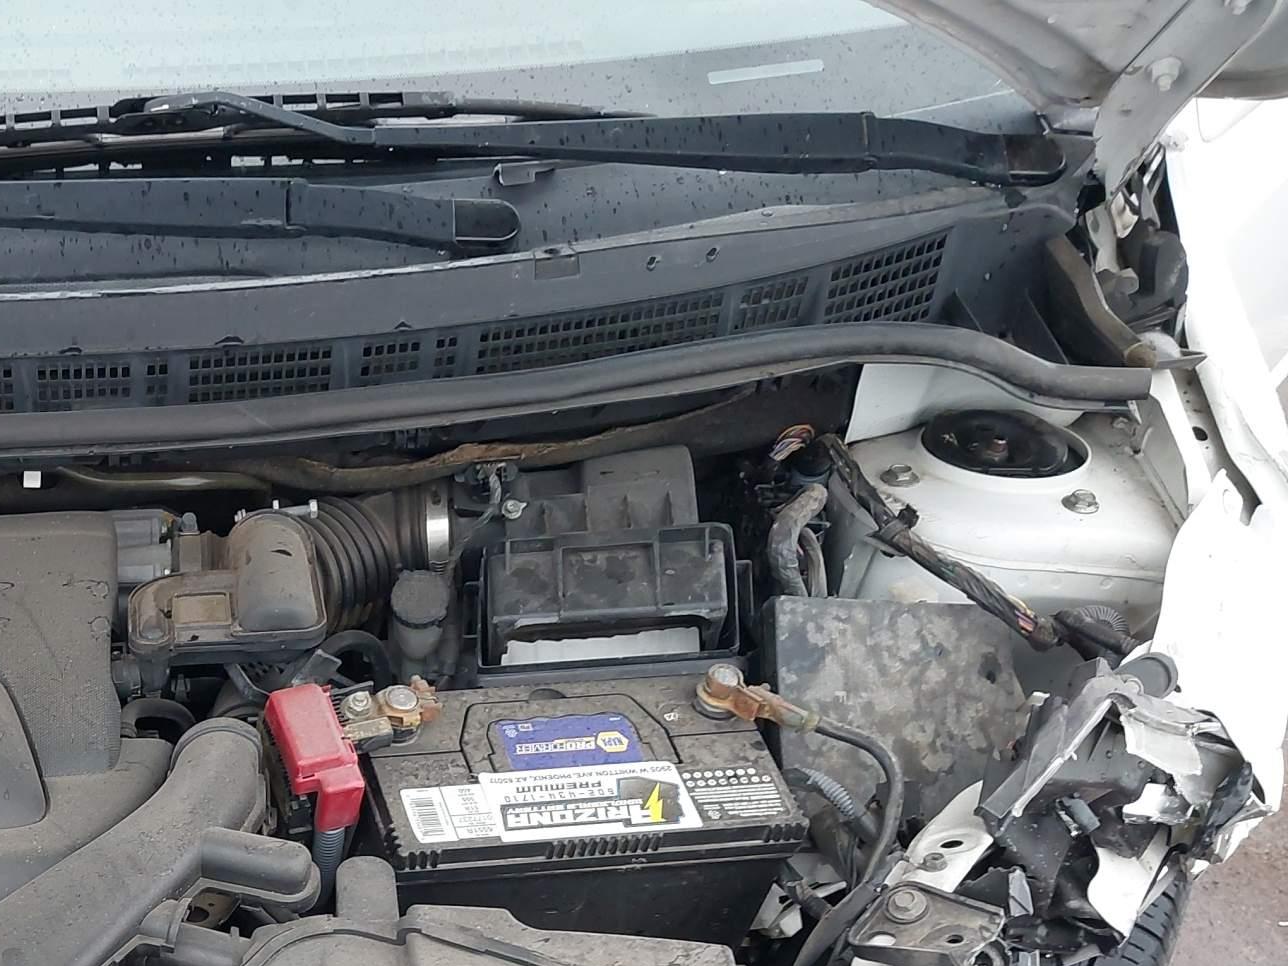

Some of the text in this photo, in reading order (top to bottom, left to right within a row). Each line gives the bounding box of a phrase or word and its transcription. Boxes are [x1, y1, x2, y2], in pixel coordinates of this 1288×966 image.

[601, 736, 624, 746] NAPA
[515, 780, 602, 794] PREMIUM
[506, 803, 666, 827] ARIZONA
